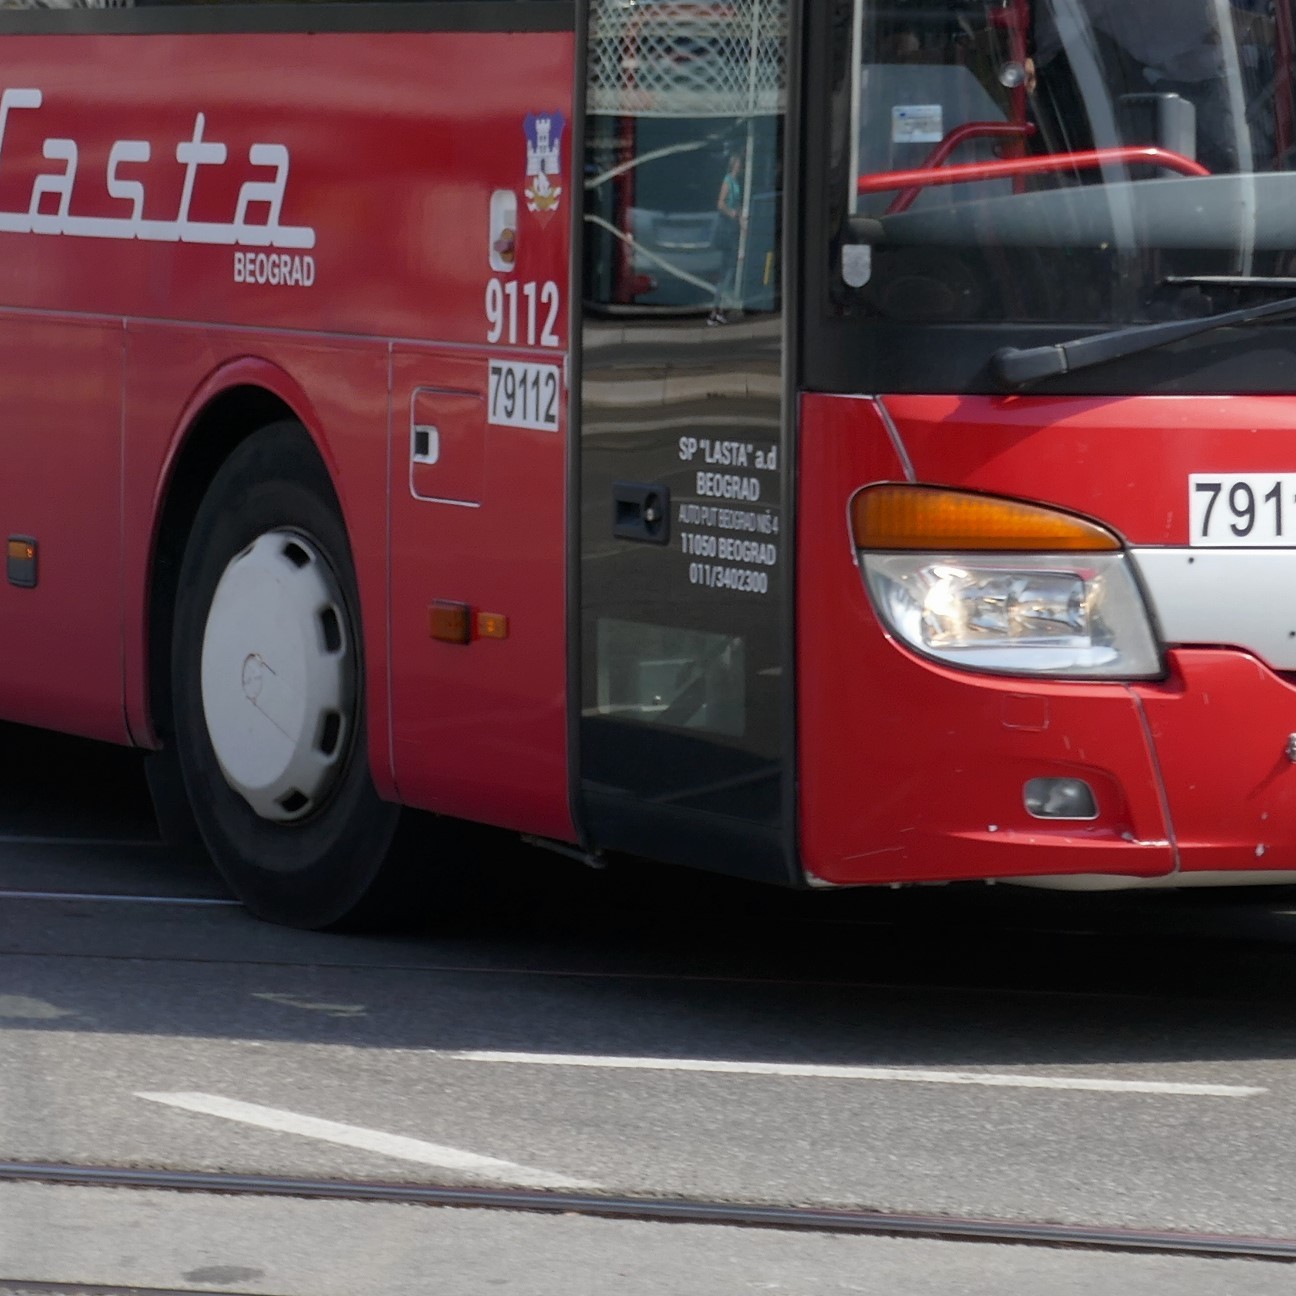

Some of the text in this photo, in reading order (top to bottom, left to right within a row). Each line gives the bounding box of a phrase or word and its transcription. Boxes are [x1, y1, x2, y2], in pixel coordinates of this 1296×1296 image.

[233, 252, 316, 287] BEOGRAD
[485, 277, 559, 347] 9112
[490, 366, 557, 424] 79112
[678, 436, 697, 461] SP
[696, 471, 760, 501] BEOGRAD
[681, 532, 776, 566] 11050 BEOGRAD
[689, 562, 768, 594] 011/3402300
